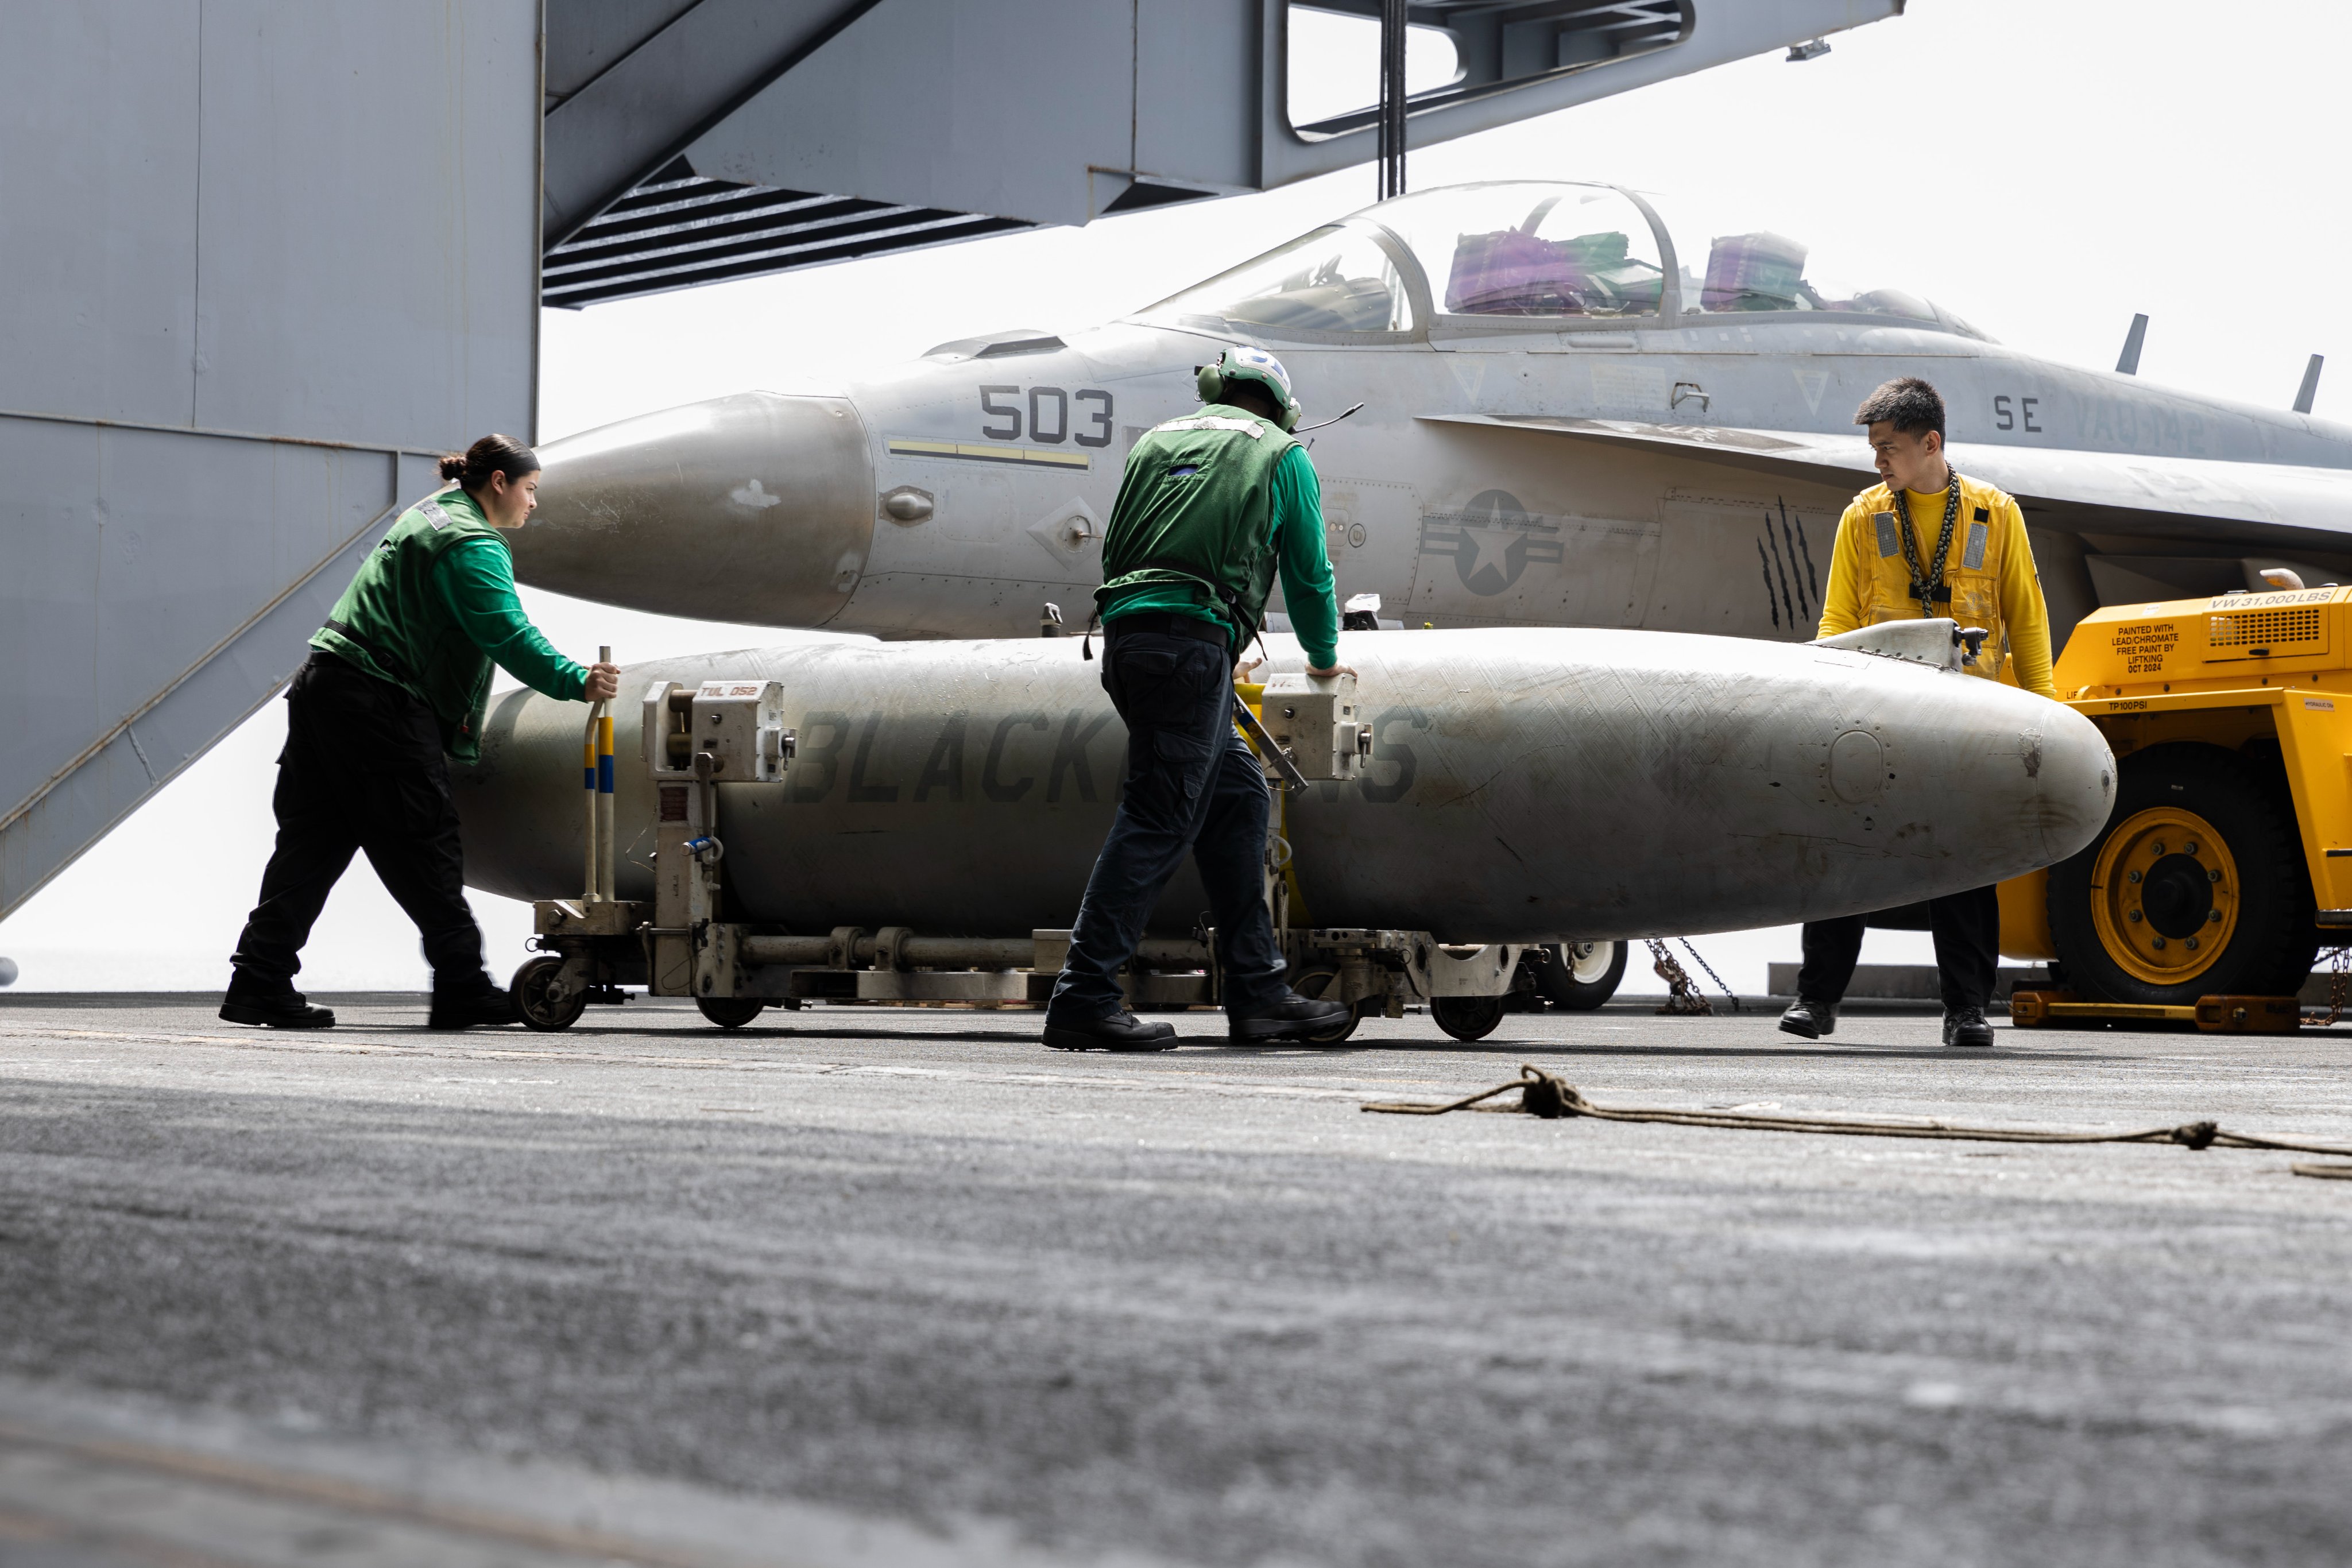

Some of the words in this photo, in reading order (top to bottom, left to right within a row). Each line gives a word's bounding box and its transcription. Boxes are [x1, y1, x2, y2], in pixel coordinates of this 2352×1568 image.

[978, 385, 1113, 448] 503
[1994, 395, 2042, 433] SE
[2212, 598, 2241, 609] VW
[2241, 594, 2296, 606] 31,000
[2297, 591, 2331, 602] LBS
[2118, 625, 2152, 636] PAINTED
[2153, 624, 2173, 633] WITH
[2112, 633, 2179, 646] LEAD/CHROMATE
[2117, 646, 2137, 655] FREE
[2139, 644, 2162, 653] PAINT
[2164, 644, 2175, 652] BY
[2128, 654, 2163, 664] LIFTKING
[2128, 664, 2141, 673] OCT
[2144, 663, 2161, 672] 2024
[2067, 691, 2078, 699] LIF
